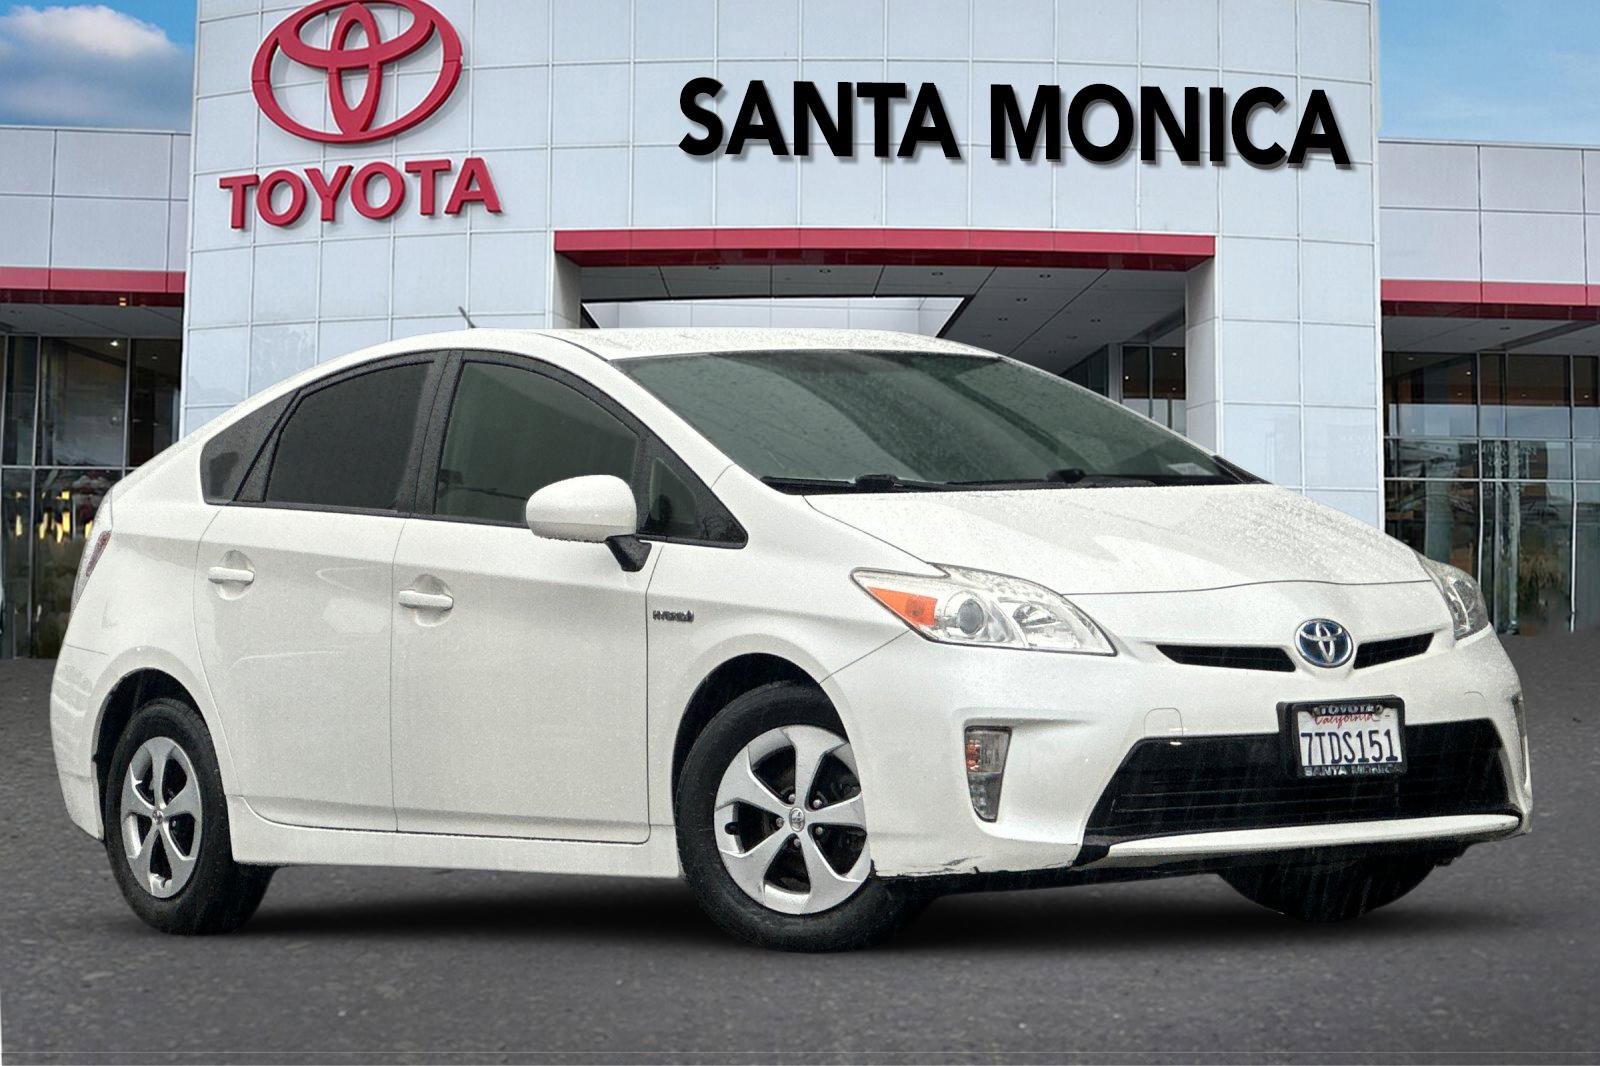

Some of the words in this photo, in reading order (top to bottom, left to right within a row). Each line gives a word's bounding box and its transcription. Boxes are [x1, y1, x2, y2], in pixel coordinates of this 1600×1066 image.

[678, 77, 962, 159] SANTA
[990, 83, 1351, 168] MONICA
[219, 157, 502, 229] TOYOTA
[1300, 729, 1398, 766] 7TDS151
